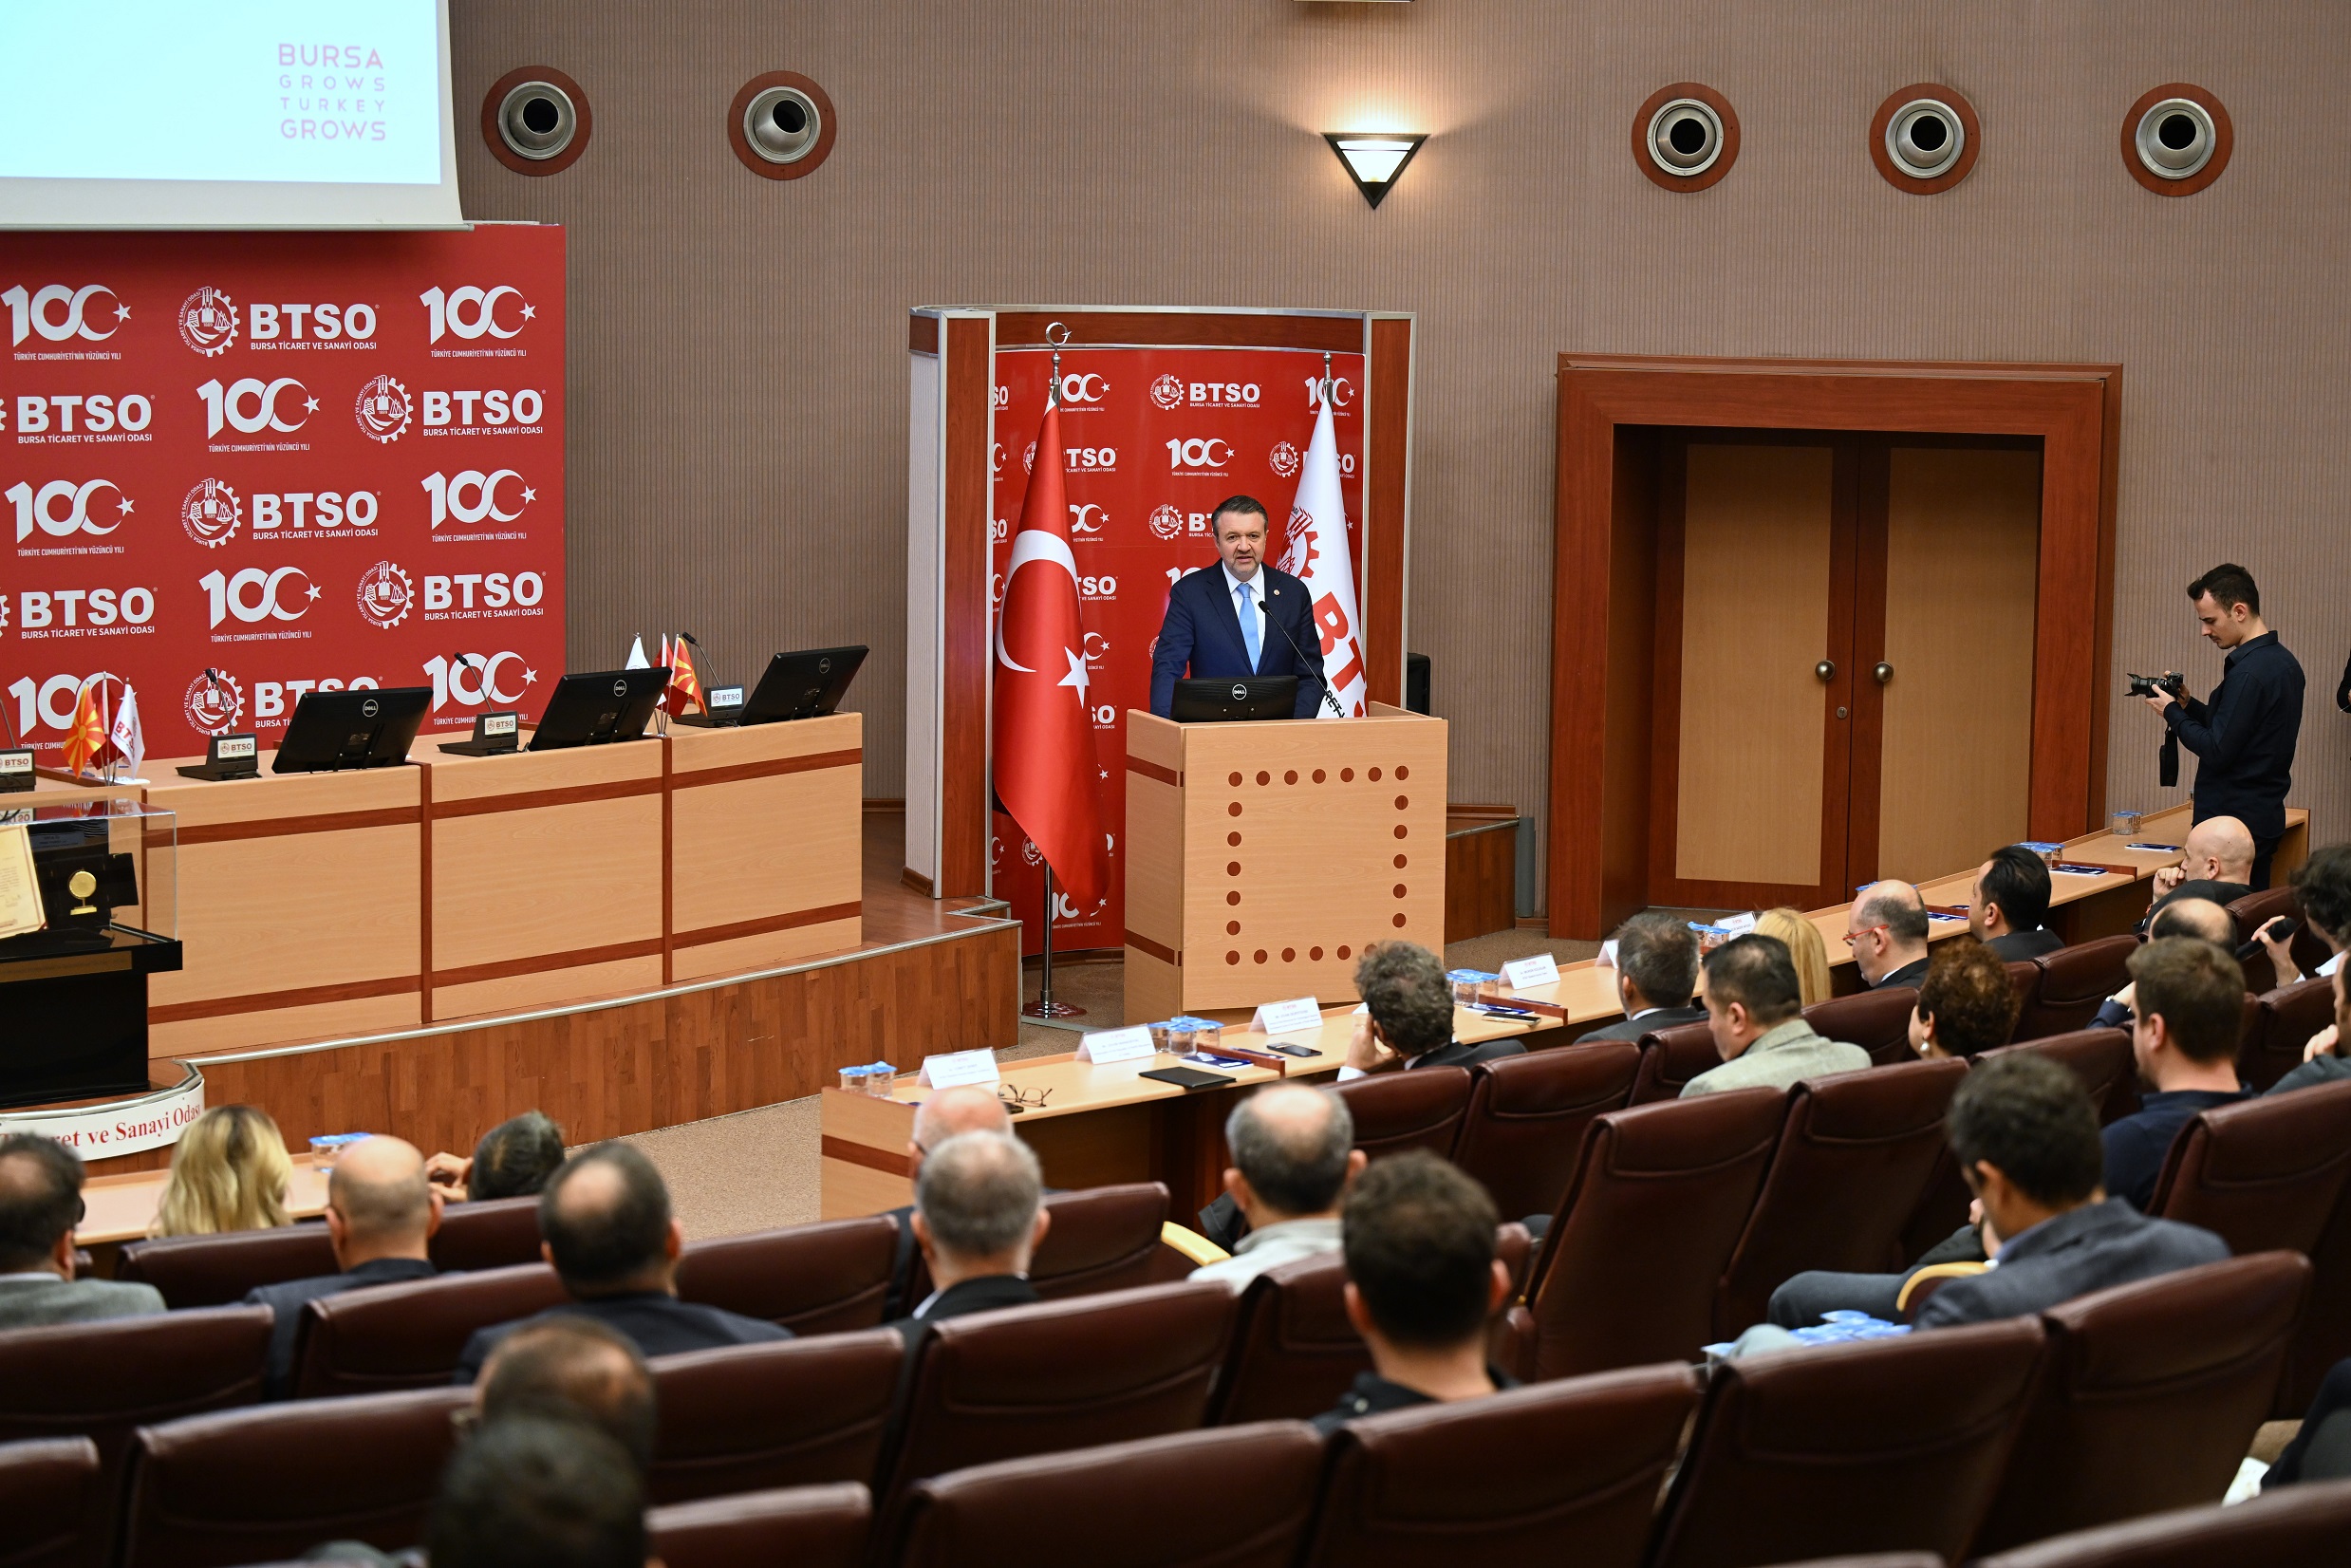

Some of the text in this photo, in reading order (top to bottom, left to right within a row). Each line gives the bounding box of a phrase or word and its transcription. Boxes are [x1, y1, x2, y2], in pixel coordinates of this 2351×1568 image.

[278, 44, 383, 69] BURSA
[279, 74, 385, 91] GROWS
[280, 97, 385, 113] TURKEY
[280, 120, 386, 141] GROWS
[251, 304, 376, 339] BTSO
[278, 341, 309, 349] TİCARET
[325, 341, 351, 349] SANAYİ
[1190, 383, 1260, 402] BTSO
[18, 395, 152, 432] BTSO
[423, 389, 543, 425] BTSO
[47, 434, 82, 442] TİCARET
[96, 433, 125, 442] SANAYİ
[493, 426, 518, 435] SANAYİ
[1064, 447, 1116, 467] TSO
[253, 491, 378, 529] BTSO
[327, 529, 353, 537] SANAYİ
[424, 571, 543, 609] BTSO
[21, 588, 155, 630] BTSO
[451, 610, 481, 619] TİCARET
[494, 608, 519, 617] SANAYİ
[100, 625, 128, 635] SANAYİ
[255, 719, 281, 728] BURSA
[434, 717, 454, 726] TÜRKİYE
[518, 713, 529, 721] YILI
[231, 742, 252, 751] BTSO
[5, 758, 29, 767] BTSO
[87, 1129, 109, 1145] ve
[116, 1111, 170, 1141] Sanayi
